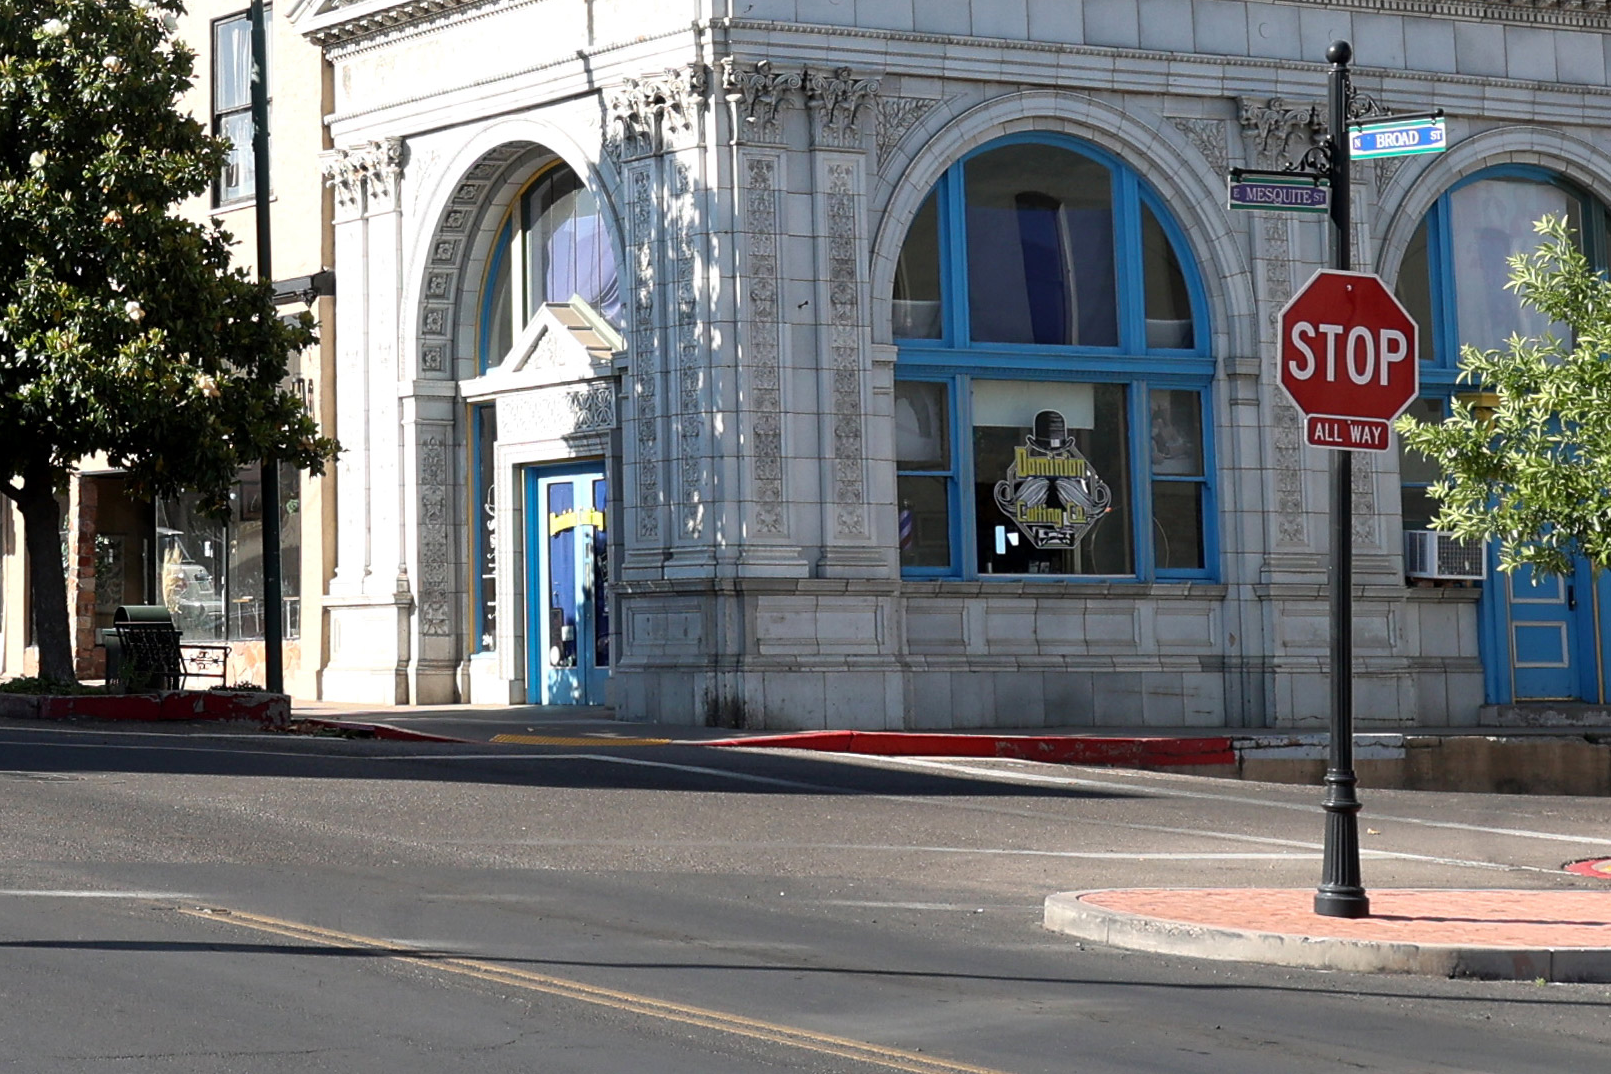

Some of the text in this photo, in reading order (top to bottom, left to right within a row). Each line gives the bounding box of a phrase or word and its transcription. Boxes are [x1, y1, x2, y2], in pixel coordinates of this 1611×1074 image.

[1354, 130, 1443, 149] N BROAD ST
[1233, 187, 1325, 205] E MESQUITE ST
[1289, 321, 1408, 386] STOP
[1314, 422, 1381, 445] ALL WAY
[1015, 447, 1086, 478] Dominion
[1017, 501, 1062, 529] Cutting
